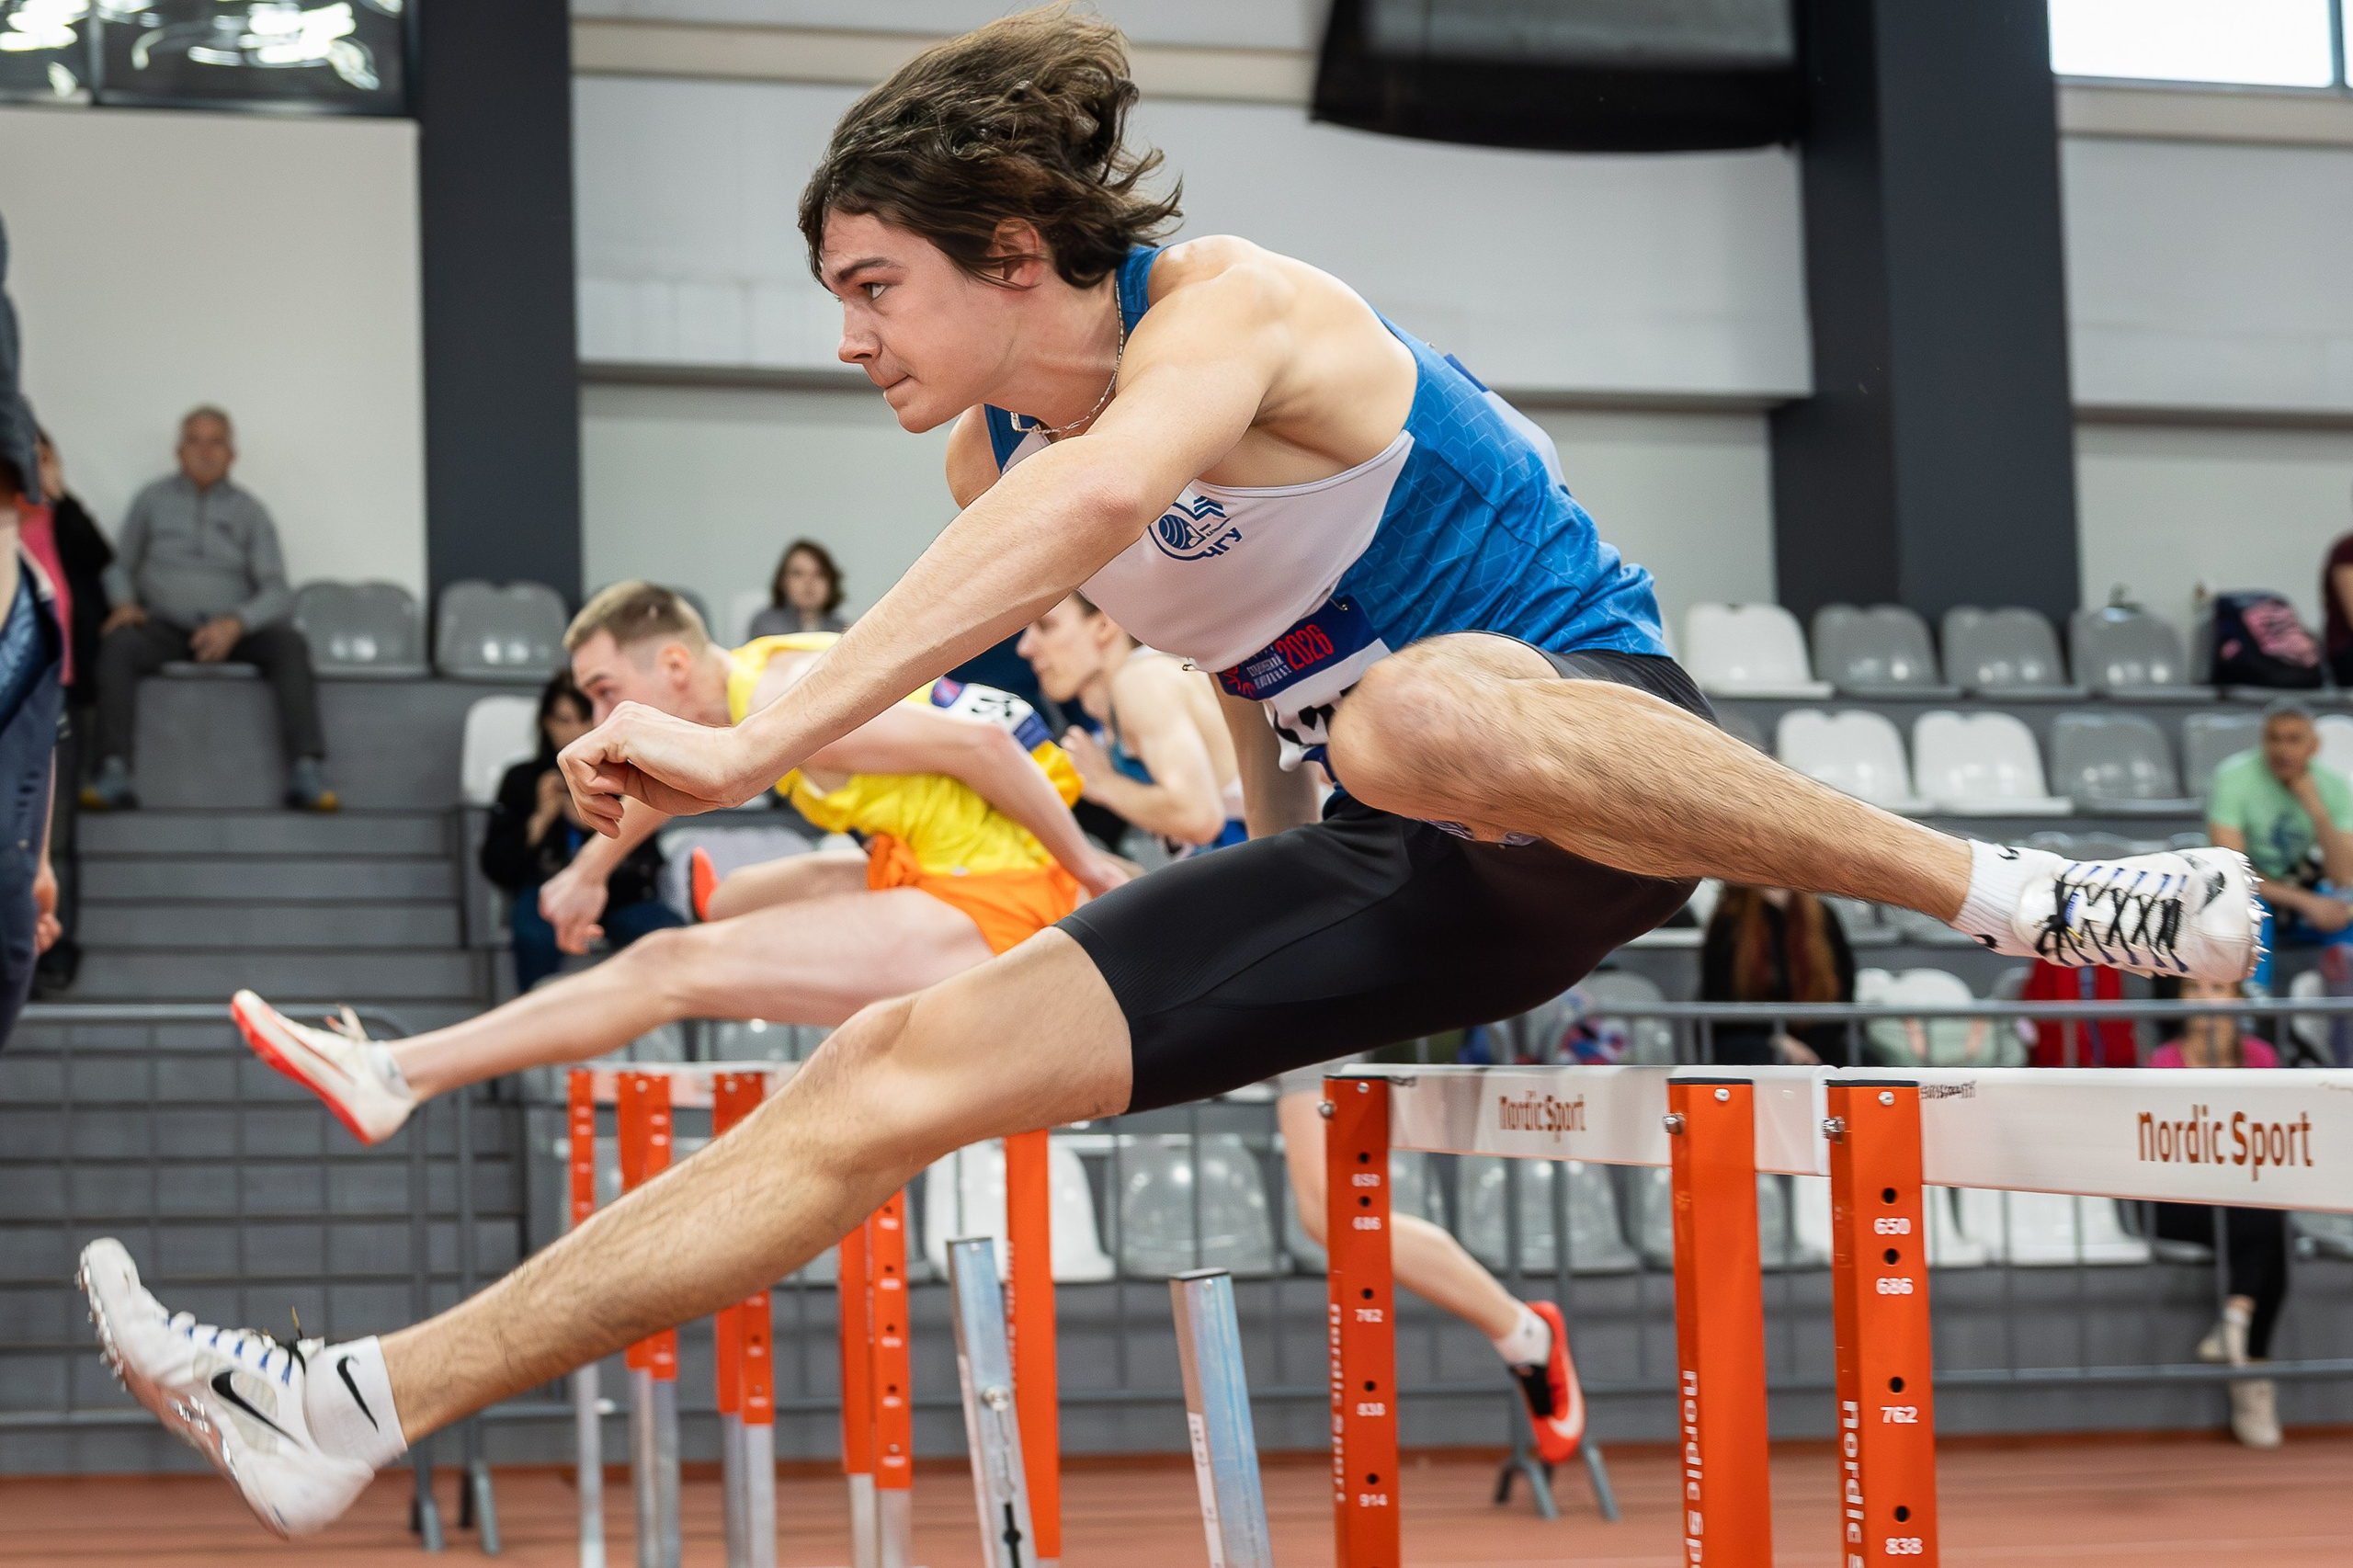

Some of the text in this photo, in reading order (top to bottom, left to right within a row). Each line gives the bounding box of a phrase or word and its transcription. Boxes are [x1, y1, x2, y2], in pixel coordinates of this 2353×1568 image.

[1275, 624, 1335, 670] 2026
[1545, 1094, 1586, 1142] Sport
[2232, 1110, 2314, 1181] Sport
[1873, 1218, 1912, 1235] 650
[1875, 1278, 1915, 1295] 686
[1354, 1308, 1383, 1323] 762
[1880, 1405, 1919, 1424] 762
[1358, 1493, 1389, 1507] 914
[1884, 1537, 1924, 1555] 838
